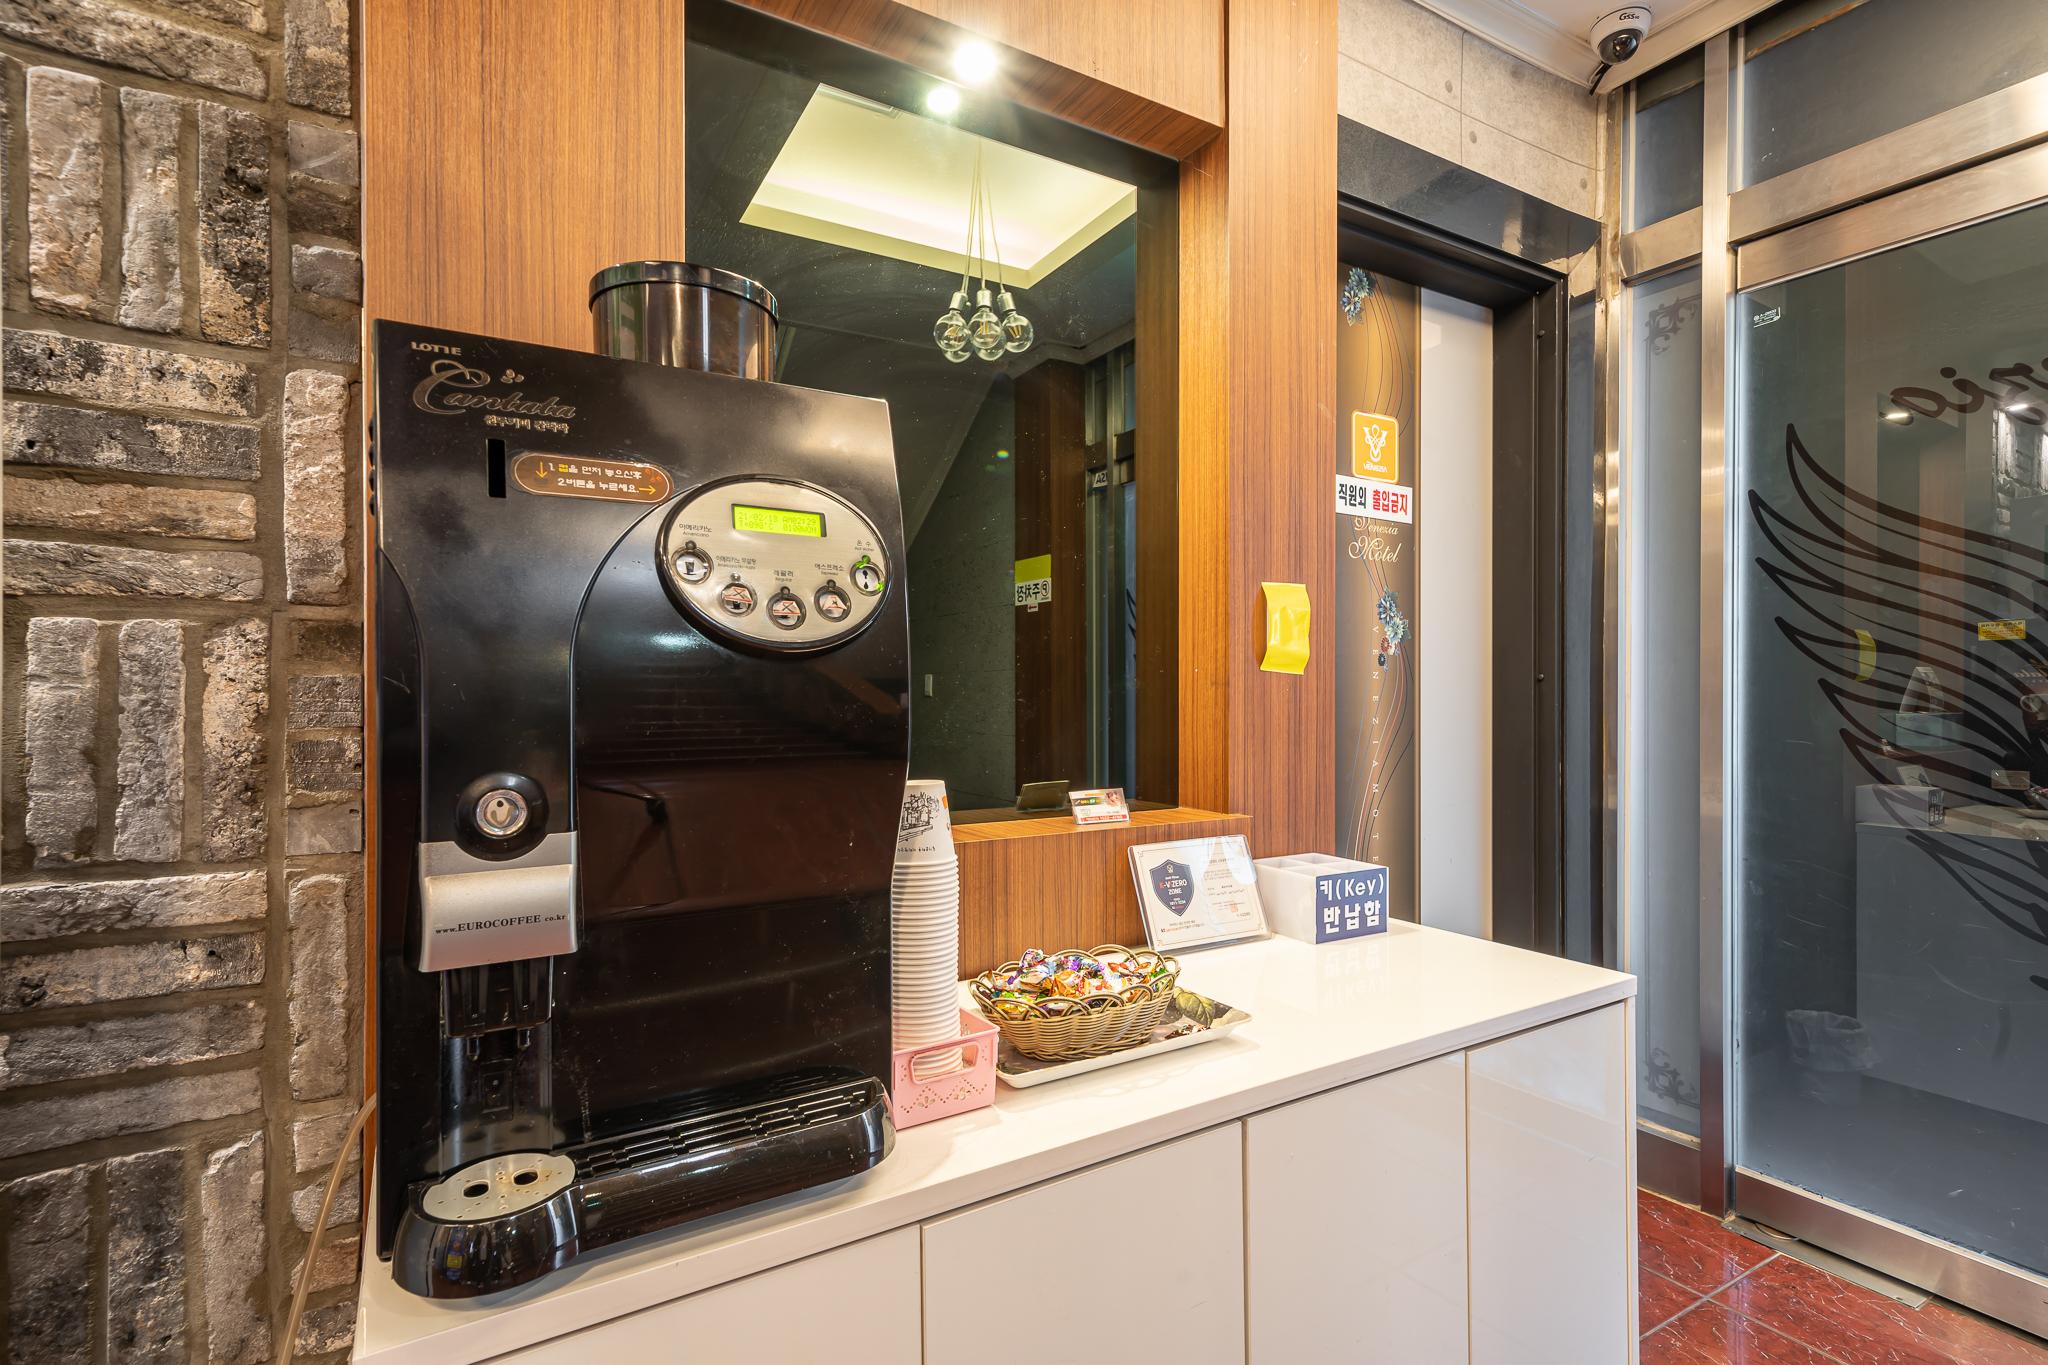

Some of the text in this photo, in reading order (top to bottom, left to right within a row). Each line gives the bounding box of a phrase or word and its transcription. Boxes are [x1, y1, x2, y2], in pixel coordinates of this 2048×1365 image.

[410, 341, 461, 356] LOTTE
[412, 359, 576, 419] Cantata
[558, 463, 578, 474] 컵을
[581, 466, 602, 476] 먼저
[605, 468, 642, 479] 놓으신후
[1338, 483, 1408, 516] 직원외 출입금지
[679, 523, 712, 532] 아메리카노
[1354, 515, 1399, 535] Venezia
[1348, 535, 1402, 563] Motel
[815, 563, 845, 571] 에스프레소
[1319, 873, 1384, 901] 키(Key)
[544, 914, 566, 922] co.kr
[1323, 900, 1381, 934] 반납함
